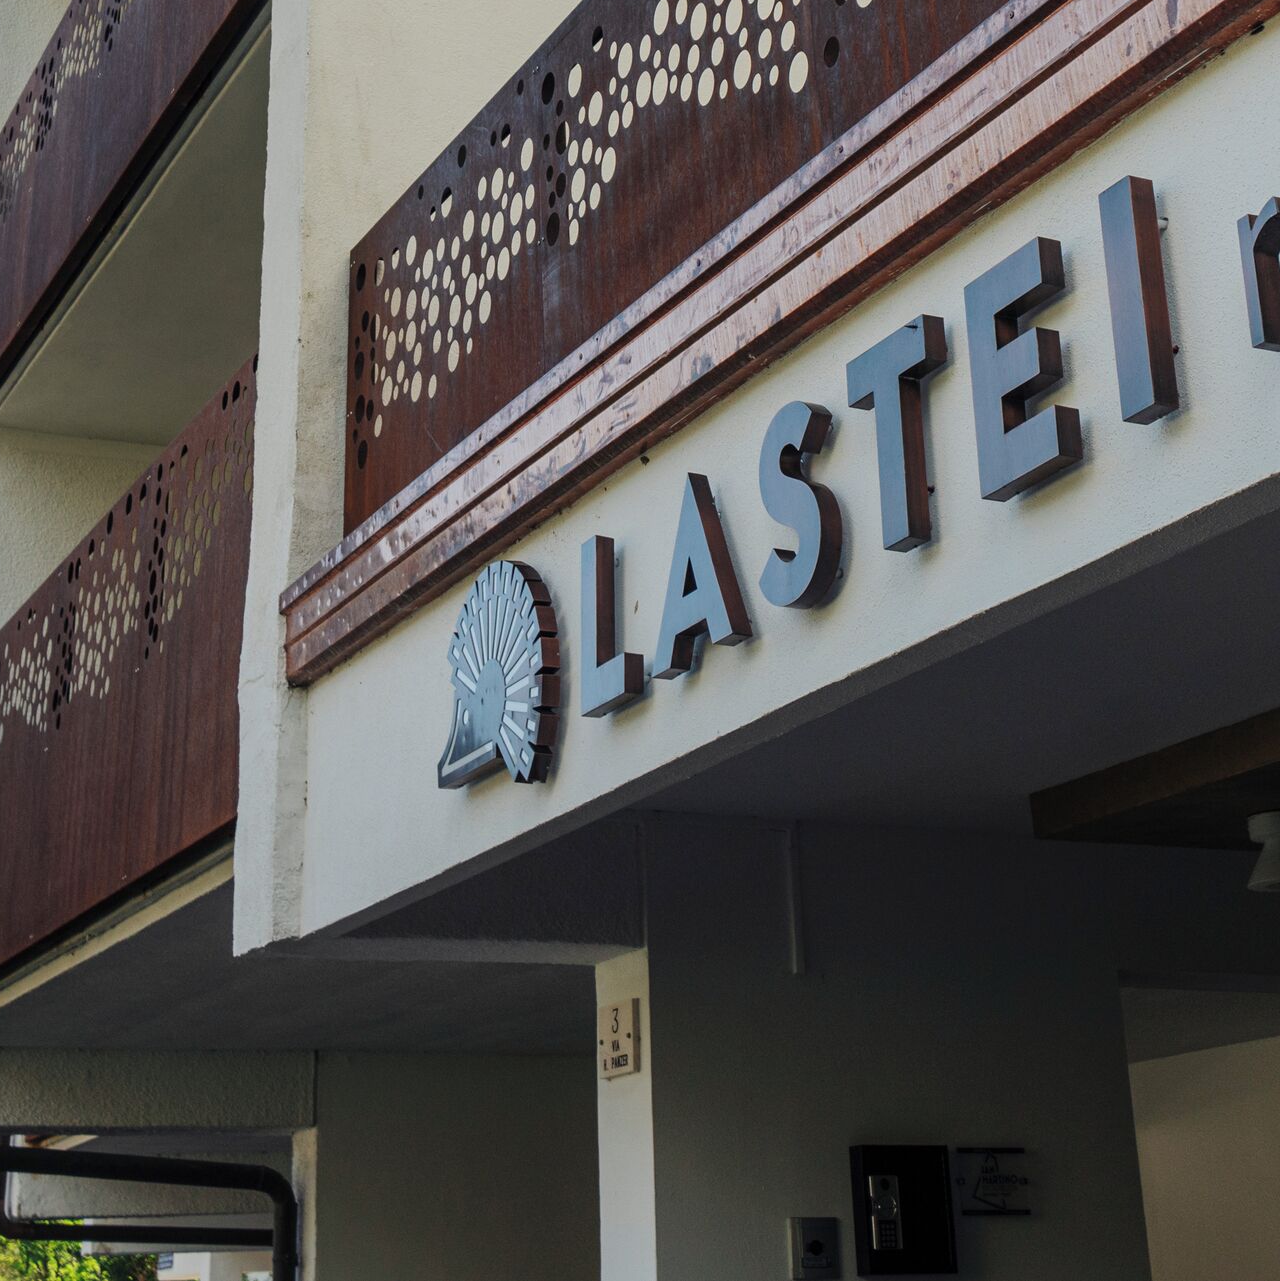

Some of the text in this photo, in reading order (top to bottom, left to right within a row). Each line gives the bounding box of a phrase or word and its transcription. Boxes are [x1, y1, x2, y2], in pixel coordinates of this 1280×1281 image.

[581, 176, 1180, 718] LASTEI
[611, 1008, 619, 1034] 3
[612, 1039, 621, 1052] VIA
